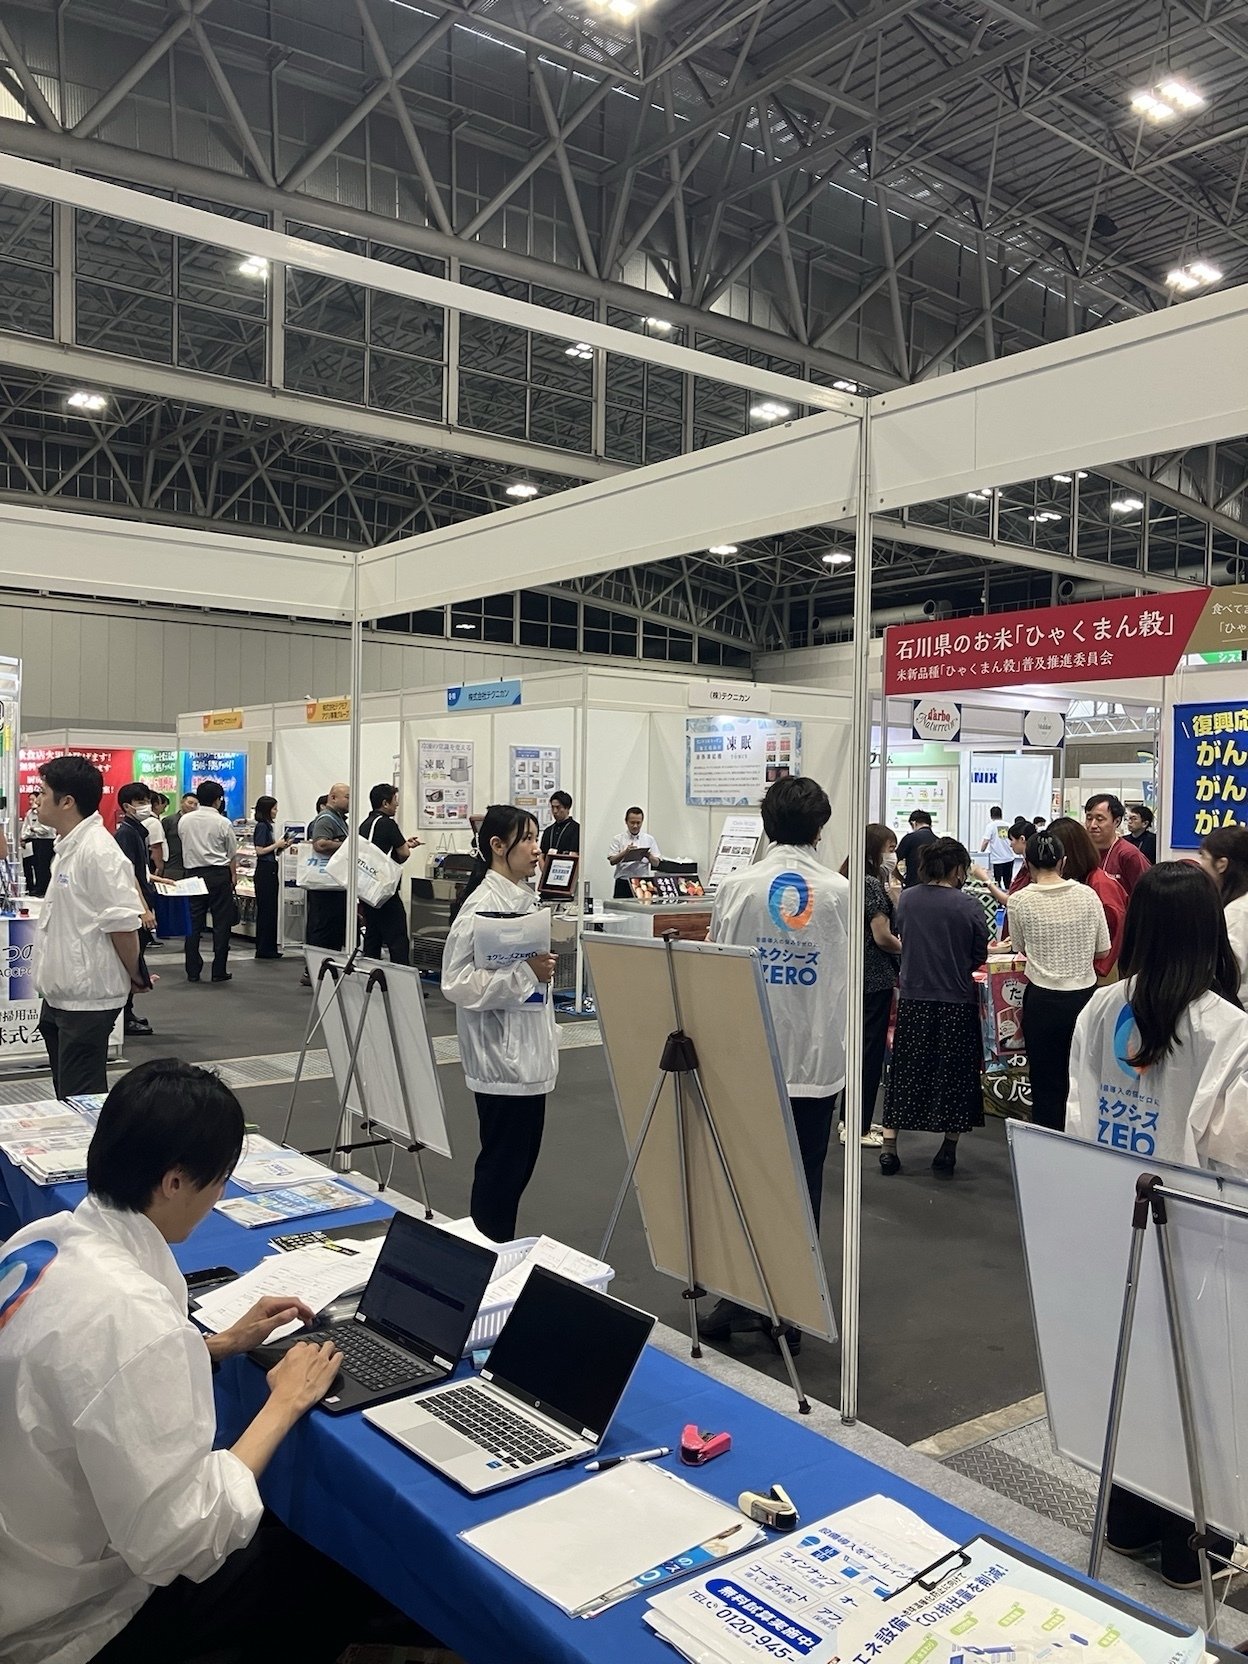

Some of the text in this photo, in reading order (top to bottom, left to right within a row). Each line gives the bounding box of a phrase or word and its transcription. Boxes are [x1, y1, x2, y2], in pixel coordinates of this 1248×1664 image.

[896, 611, 1174, 661] 石川県のお米「ひゃくまん穀」
[896, 649, 1114, 682] 米新品種「ひゃくまん穀」普及推進委員会
[468, 689, 509, 701] 株式会社テクニカン
[1196, 740, 1248, 767] がん
[971, 772, 998, 783] NIX
[1195, 775, 1247, 802] がん
[0, 1008, 39, 1022] 掃用品
[780, 1551, 839, 1586] ラインナップ
[749, 1563, 808, 1602] コーディネート
[688, 1590, 706, 1605] TEL
[718, 1585, 816, 1651] 無料試算実施中
[817, 1606, 844, 1625] アフ
